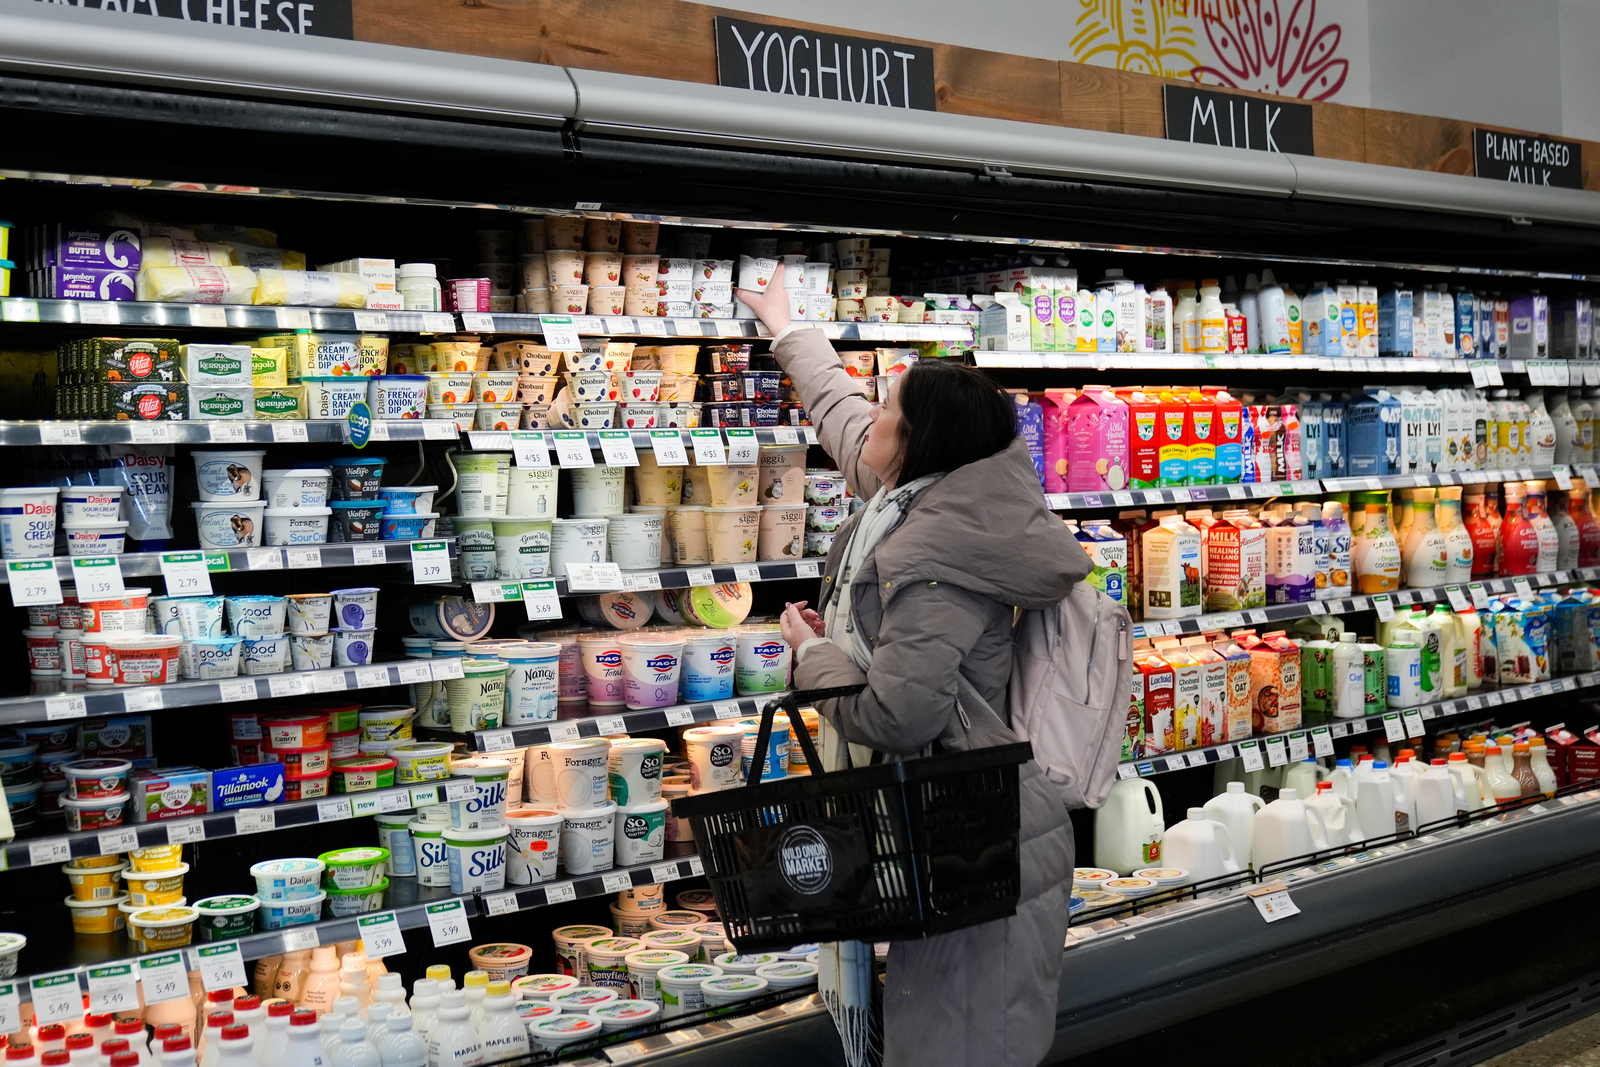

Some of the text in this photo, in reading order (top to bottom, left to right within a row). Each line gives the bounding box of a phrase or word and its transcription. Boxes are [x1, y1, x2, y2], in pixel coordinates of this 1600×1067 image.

[731, 25, 915, 109] YOGHURT
[1190, 96, 1281, 153] MILK
[1486, 133, 1570, 167] PLANT-BASED
[1507, 165, 1551, 187] MILK
[130, 357, 151, 370] Vital
[139, 400, 159, 413] Vital
[1244, 435, 1253, 474] MILK
[1277, 434, 1285, 472] MILK
[25, 503, 56, 515] Daisy
[1150, 674, 1172, 685] Lactaid
[565, 757, 602, 768] Forager
[565, 820, 601, 829] Forager
[515, 829, 552, 839] Forager
[421, 842, 447, 867] Sil
[782, 844, 827, 860] WILD ONION
[785, 856, 827, 875] MARKET
[486, 1036, 511, 1047] MAPLE
